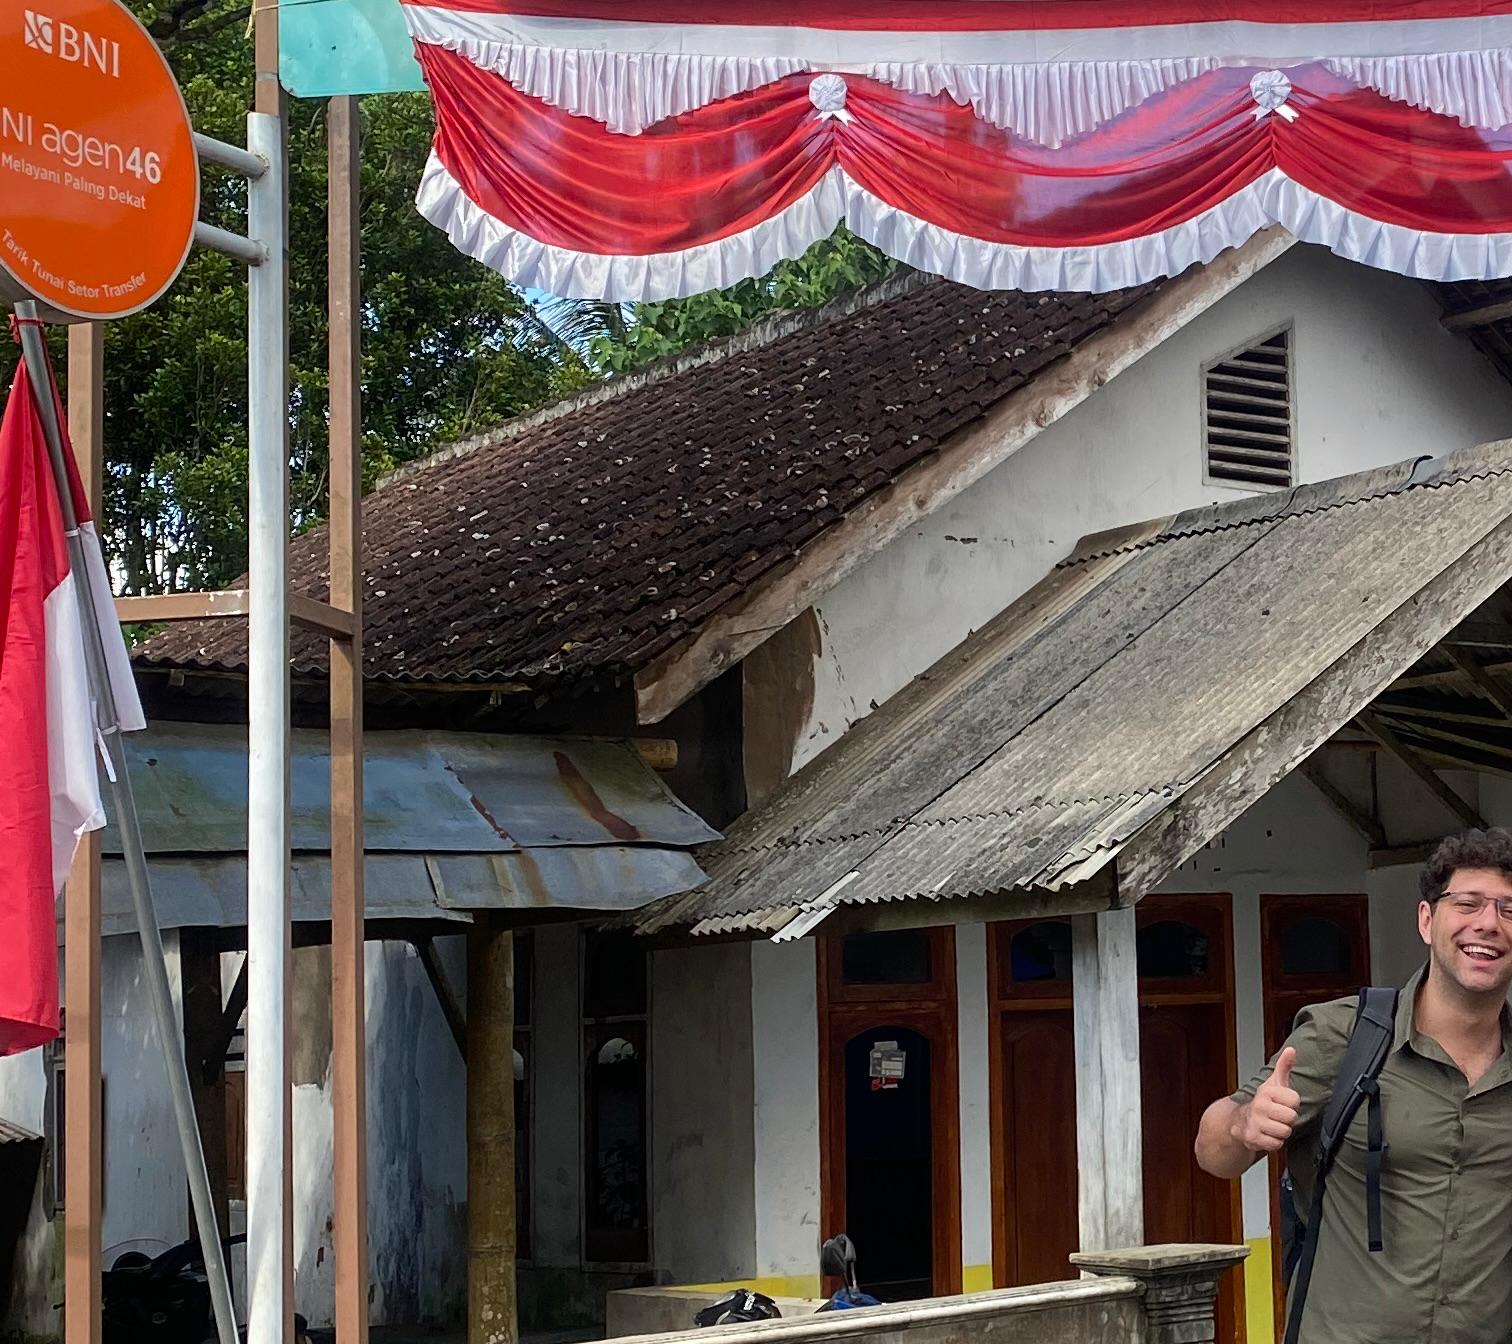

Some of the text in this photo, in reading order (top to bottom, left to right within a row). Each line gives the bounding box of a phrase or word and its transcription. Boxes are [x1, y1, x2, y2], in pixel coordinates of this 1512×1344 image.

[59, 22, 120, 78] BNI
[0, 106, 161, 184] NI agen46
[1, 151, 147, 209] Melayani Paling Dekat
[1, 229, 147, 298] Tarik Tunai Setor Transfer
